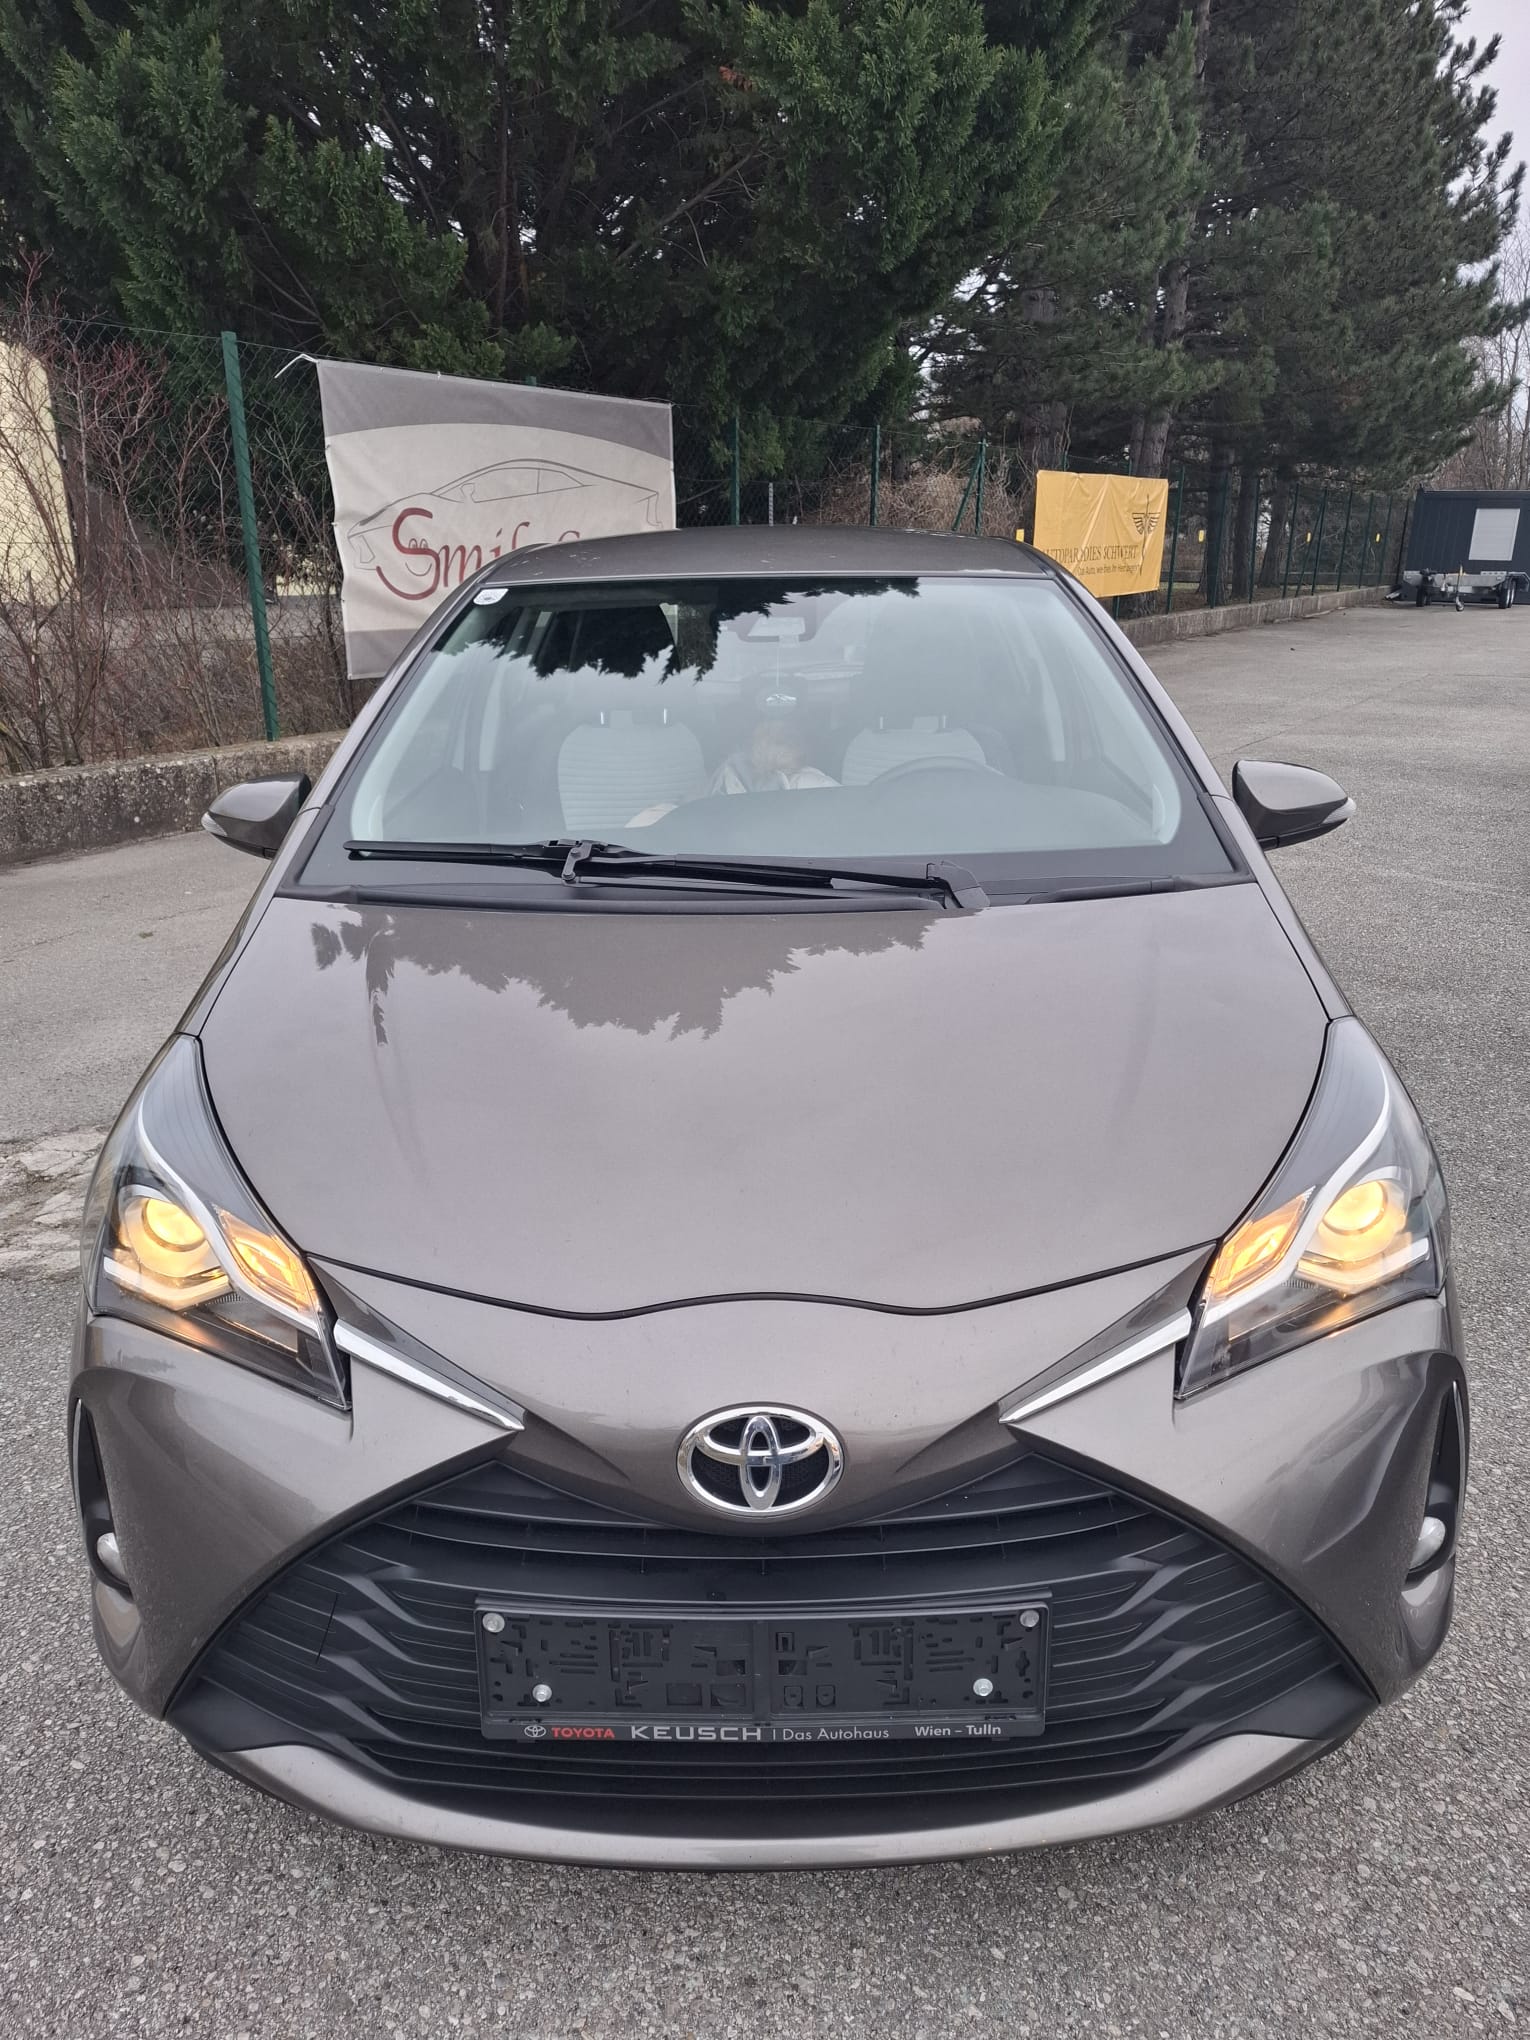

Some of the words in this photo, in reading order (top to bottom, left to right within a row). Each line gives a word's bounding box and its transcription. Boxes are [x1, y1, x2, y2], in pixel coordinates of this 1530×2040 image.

[1103, 545, 1139, 560] SCHWERT
[551, 1727, 615, 1739] TOYOTA
[631, 1725, 761, 1741] KEUSCH
[783, 1728, 812, 1741] Das
[817, 1726, 890, 1740] Autohaus
[914, 1725, 951, 1737] Wien
[965, 1724, 1002, 1736] Tulln
